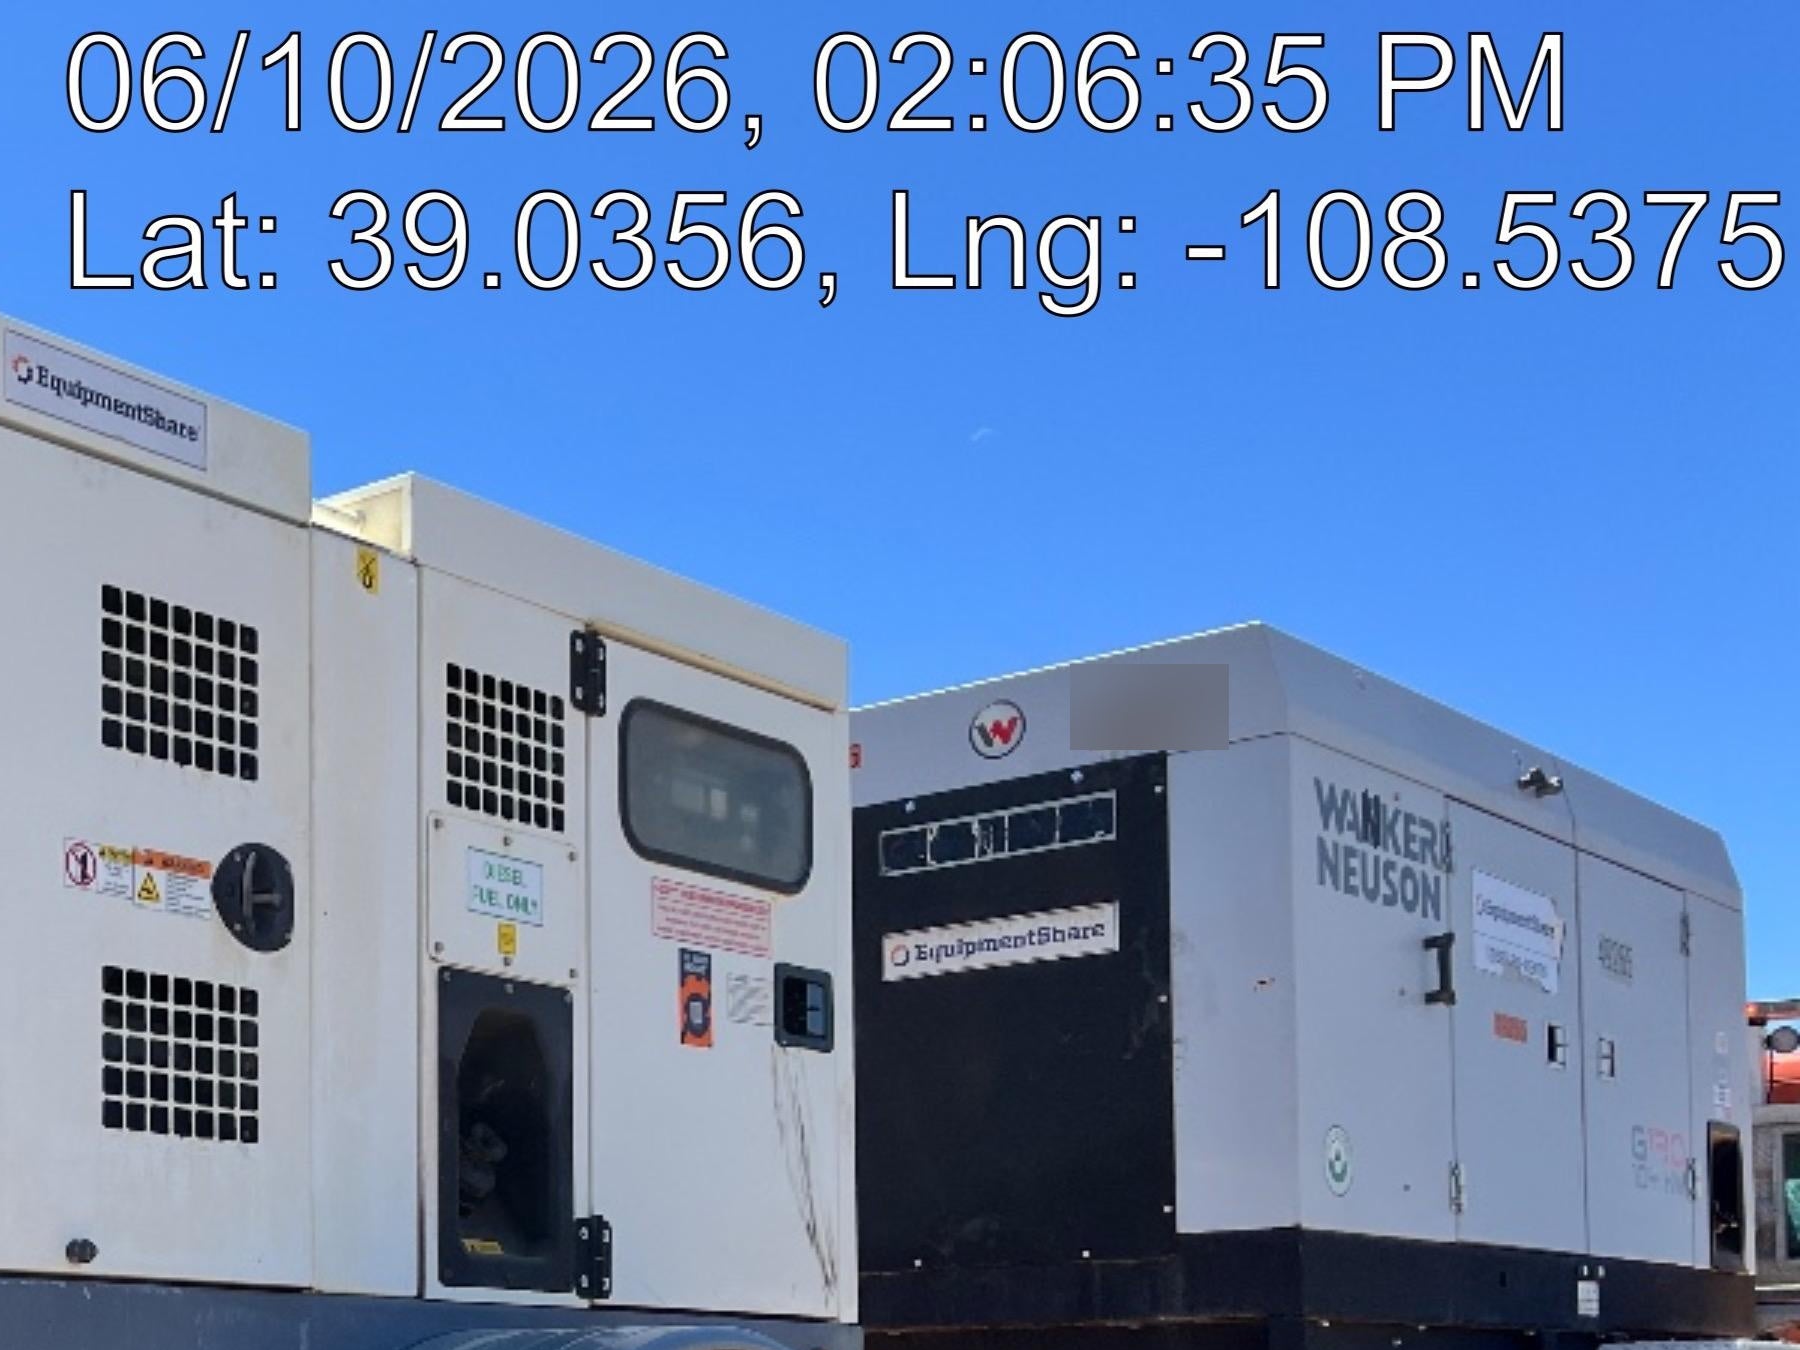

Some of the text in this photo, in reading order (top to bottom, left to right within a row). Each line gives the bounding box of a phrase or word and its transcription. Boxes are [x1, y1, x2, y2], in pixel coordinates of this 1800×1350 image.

[36, 364, 200, 442] EquipmentShare
[1316, 835, 1442, 922] NEUSON
[913, 922, 1106, 964] EquipmentShare
